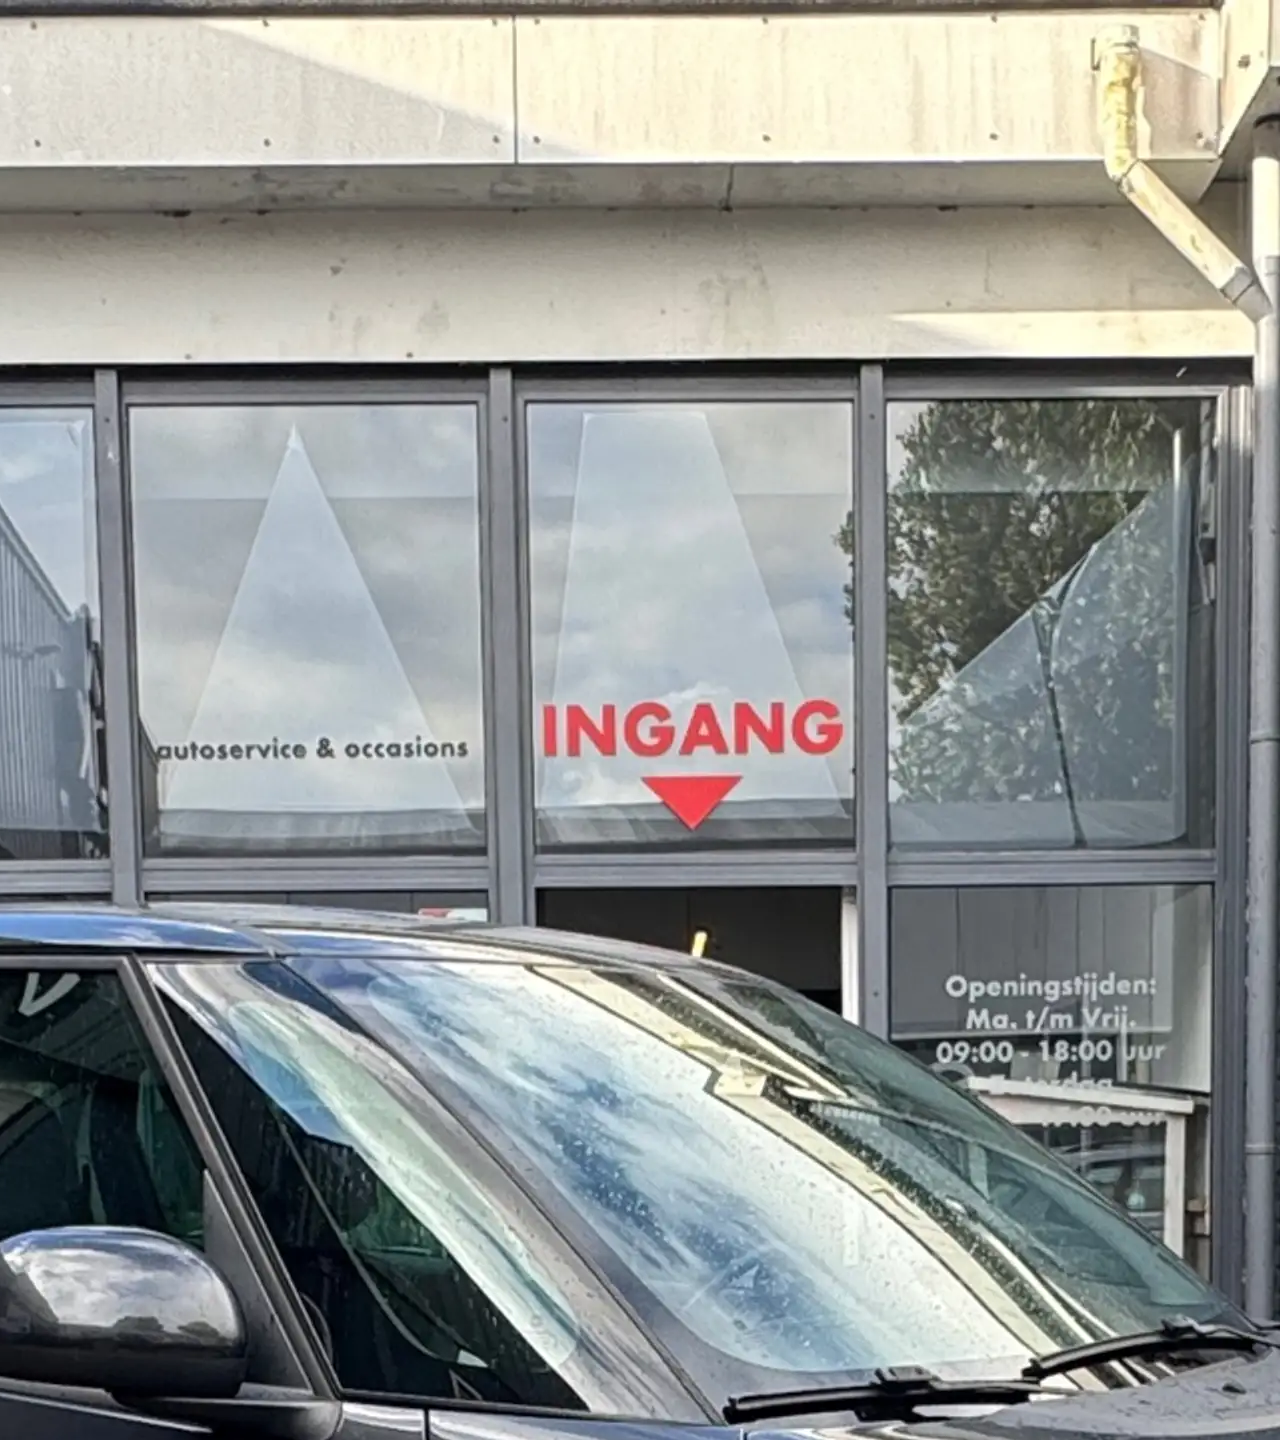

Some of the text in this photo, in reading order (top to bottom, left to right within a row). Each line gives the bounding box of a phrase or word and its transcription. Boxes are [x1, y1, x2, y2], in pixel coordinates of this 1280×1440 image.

[542, 699, 844, 758] INGANG
[157, 735, 469, 760] autoservice & occasions
[945, 972, 1157, 1003] Openingstijden:
[966, 1005, 1137, 1036] Ma. t/m Vrij.
[936, 1040, 1013, 1064] 09:00
[1038, 1040, 1113, 1062] 18:00
[1121, 1042, 1167, 1062] uur
